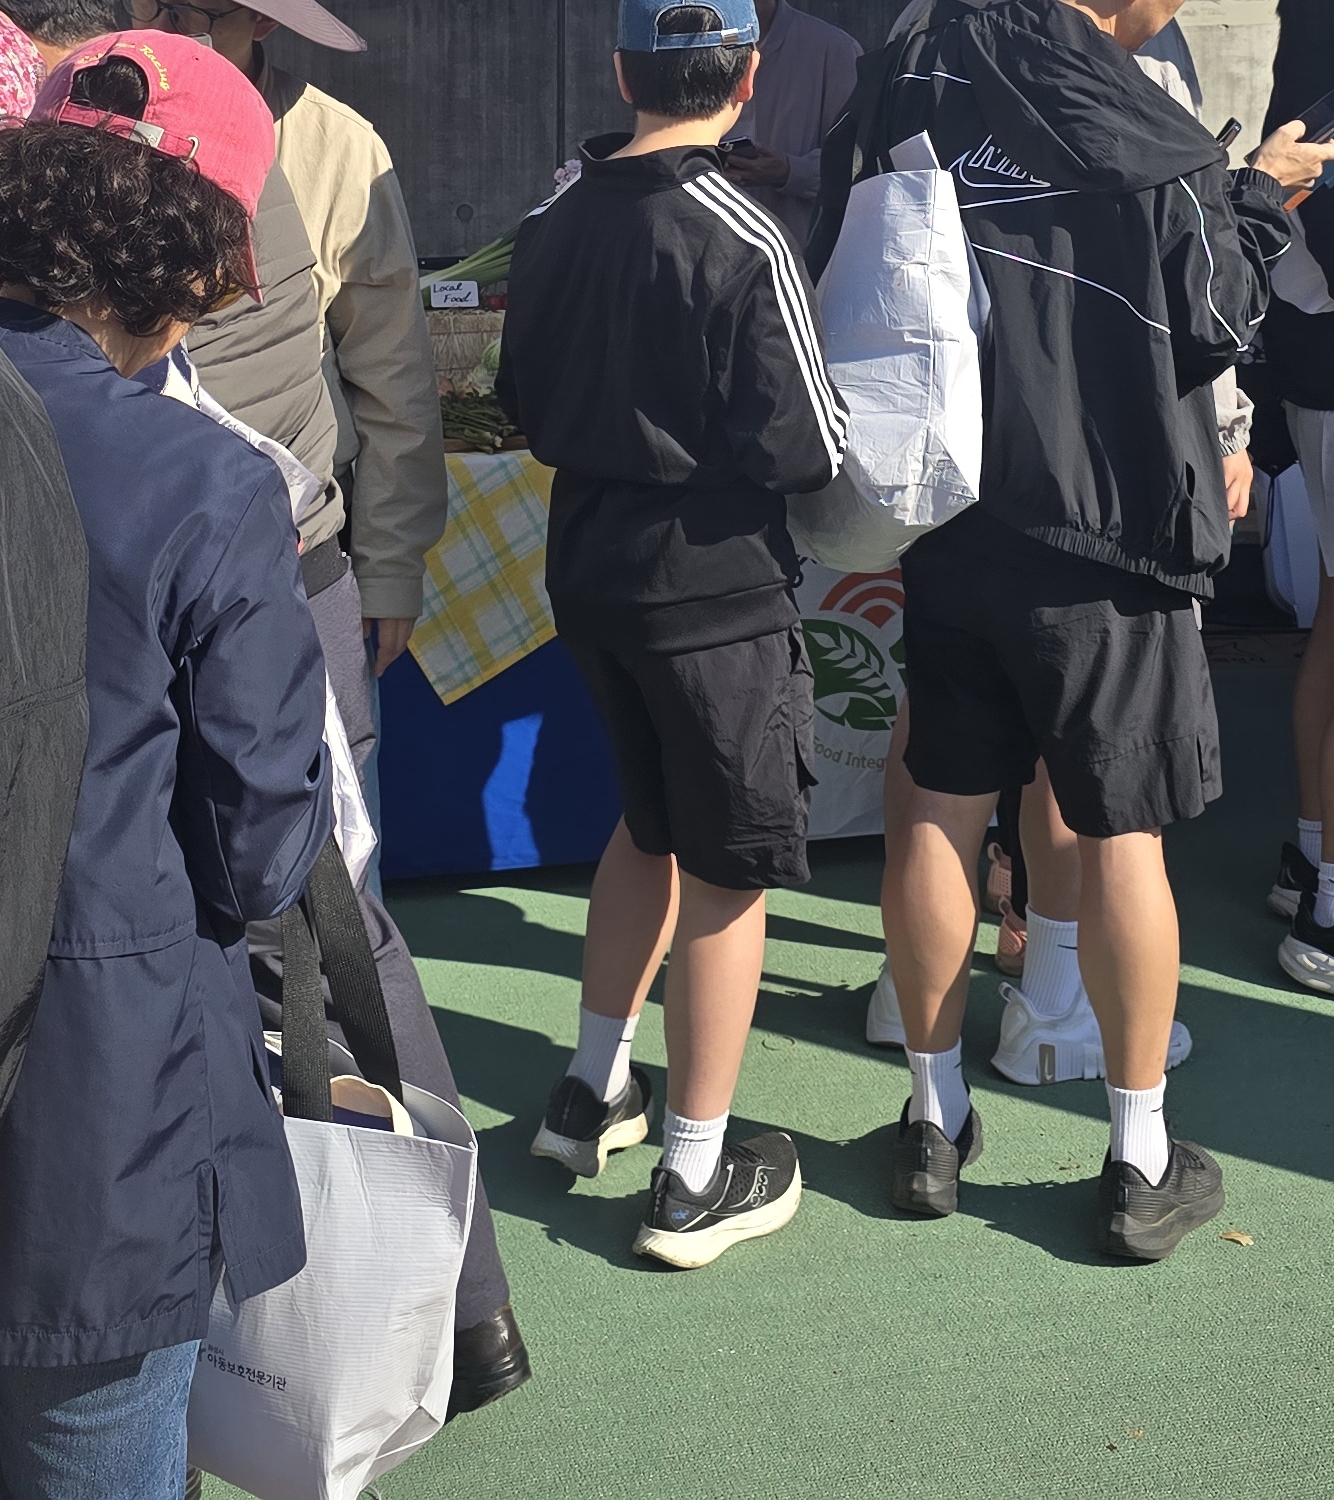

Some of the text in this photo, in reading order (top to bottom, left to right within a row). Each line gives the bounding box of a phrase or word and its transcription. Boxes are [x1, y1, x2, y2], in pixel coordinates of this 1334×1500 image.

[433, 282, 463, 293] Local
[443, 291, 473, 303] Food
[844, 752, 886, 772] Integ
[207, 1353, 287, 1392] 아동보호전문기관
